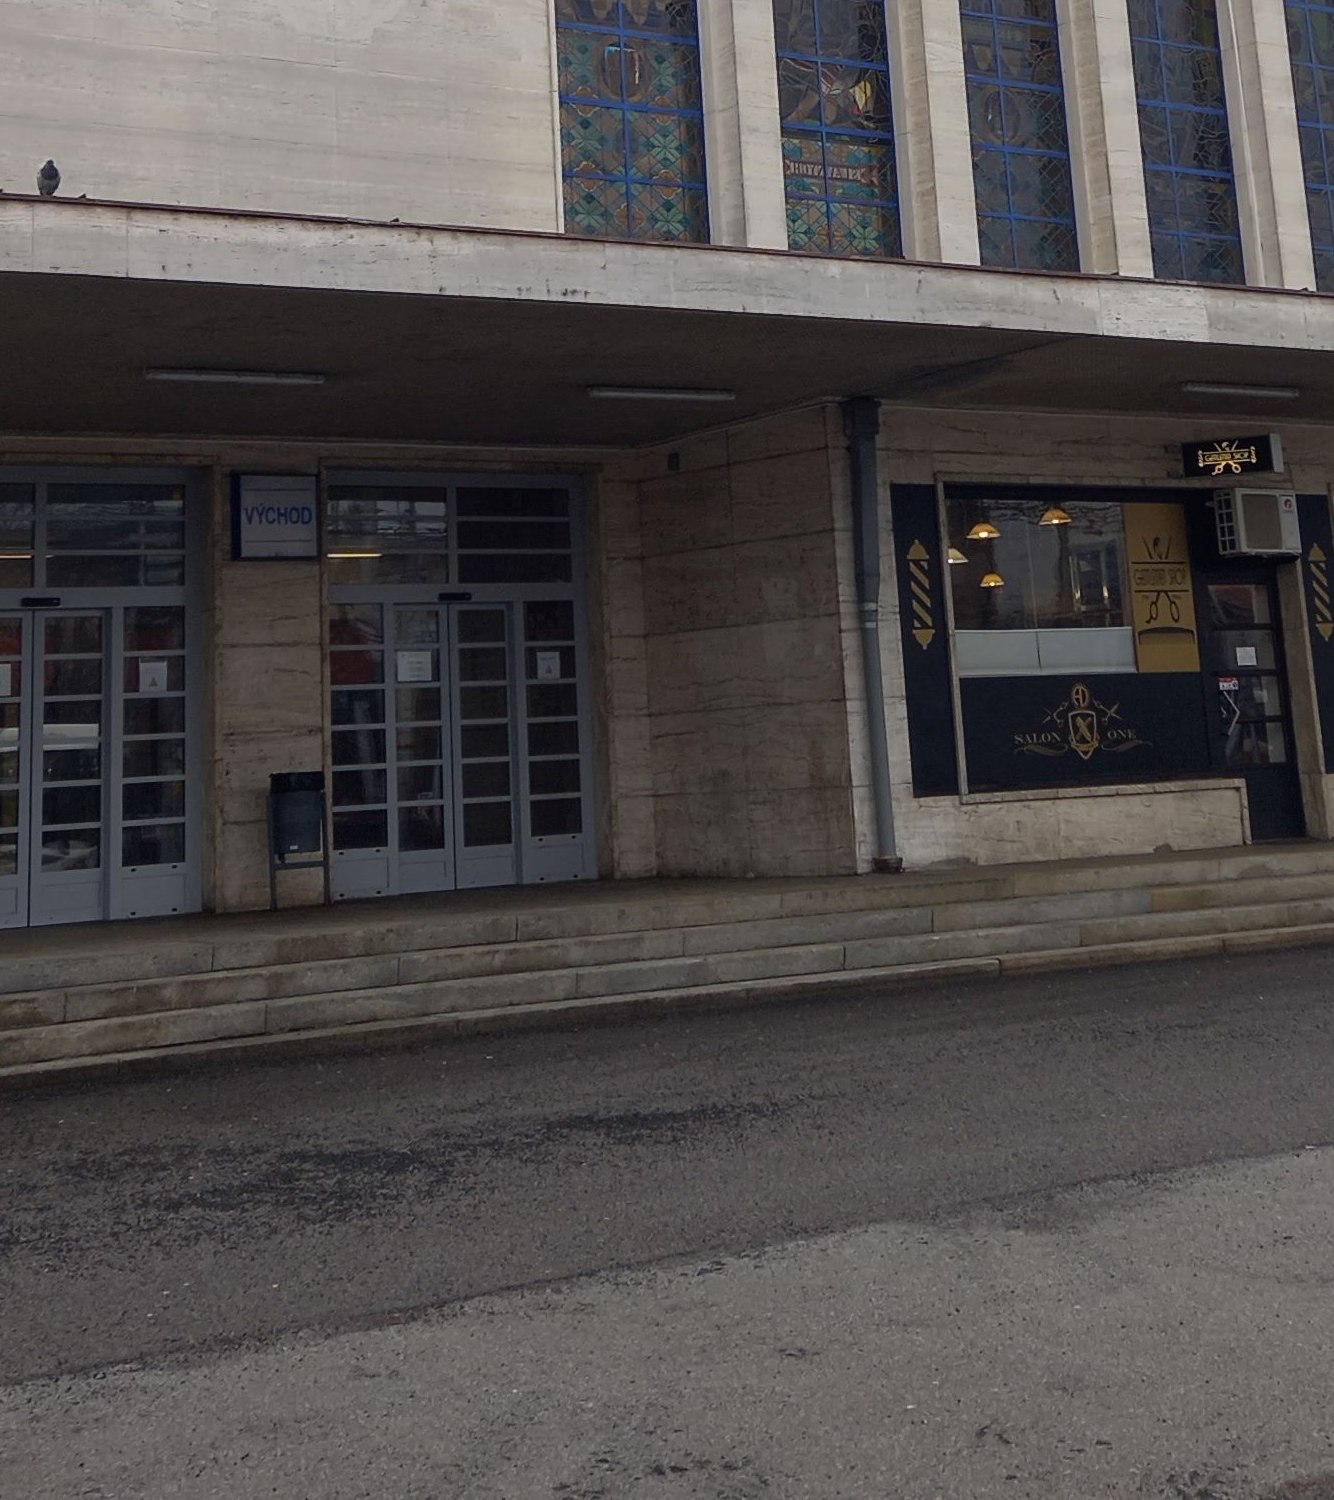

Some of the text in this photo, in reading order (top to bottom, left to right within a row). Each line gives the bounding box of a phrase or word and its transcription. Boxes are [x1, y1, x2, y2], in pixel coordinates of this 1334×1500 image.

[244, 503, 312, 525] VÝCHOD
[1013, 727, 1138, 745] SALON ONE
